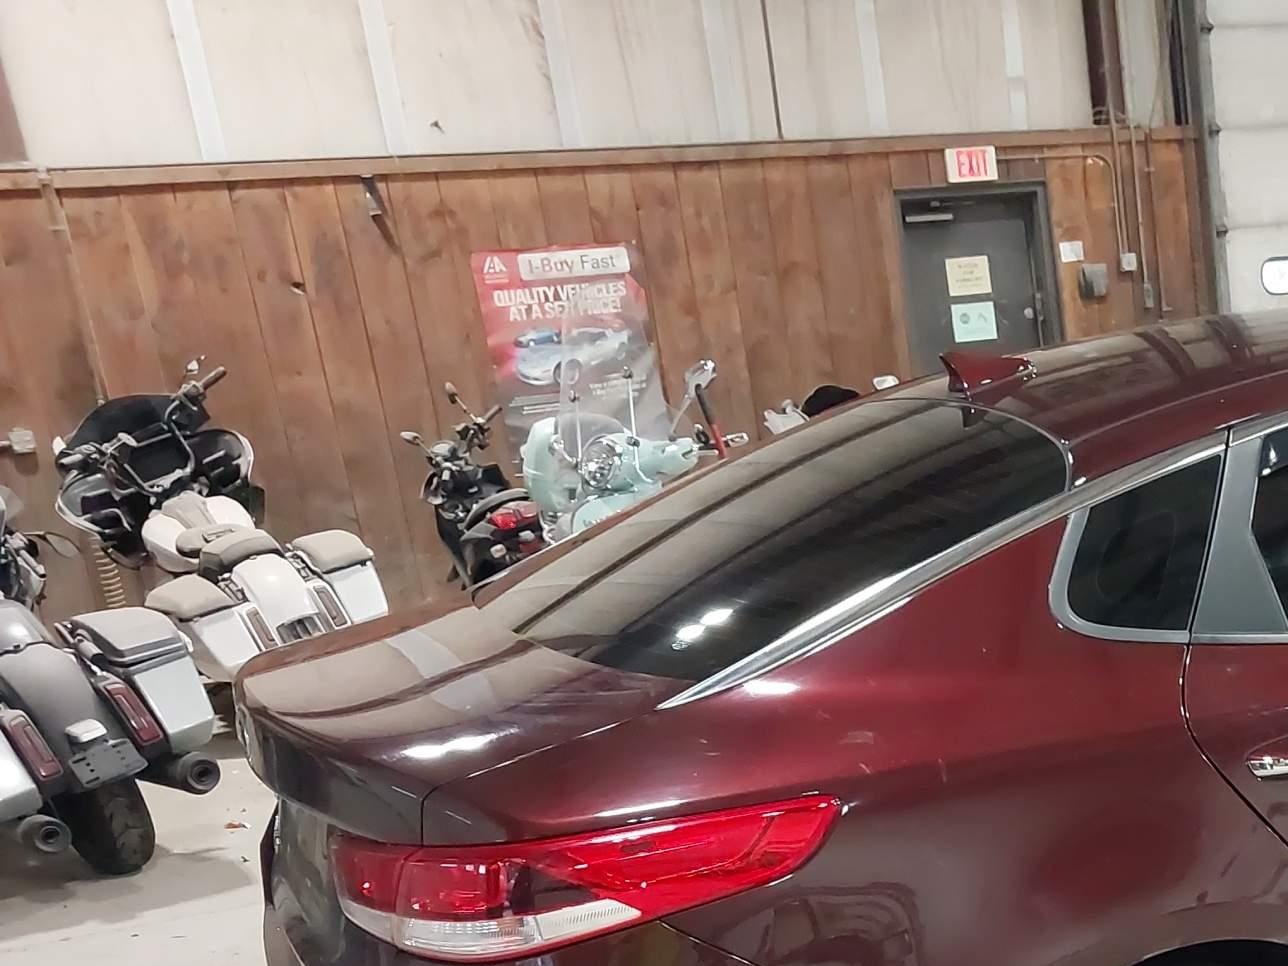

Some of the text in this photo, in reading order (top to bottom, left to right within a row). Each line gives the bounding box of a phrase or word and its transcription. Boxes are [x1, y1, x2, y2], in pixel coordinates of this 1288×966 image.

[955, 150, 988, 177] EXIT
[528, 254, 616, 274] I-Buy Fast
[493, 285, 554, 307] QUALITY
[510, 305, 528, 321] AT
[532, 304, 543, 319] A
